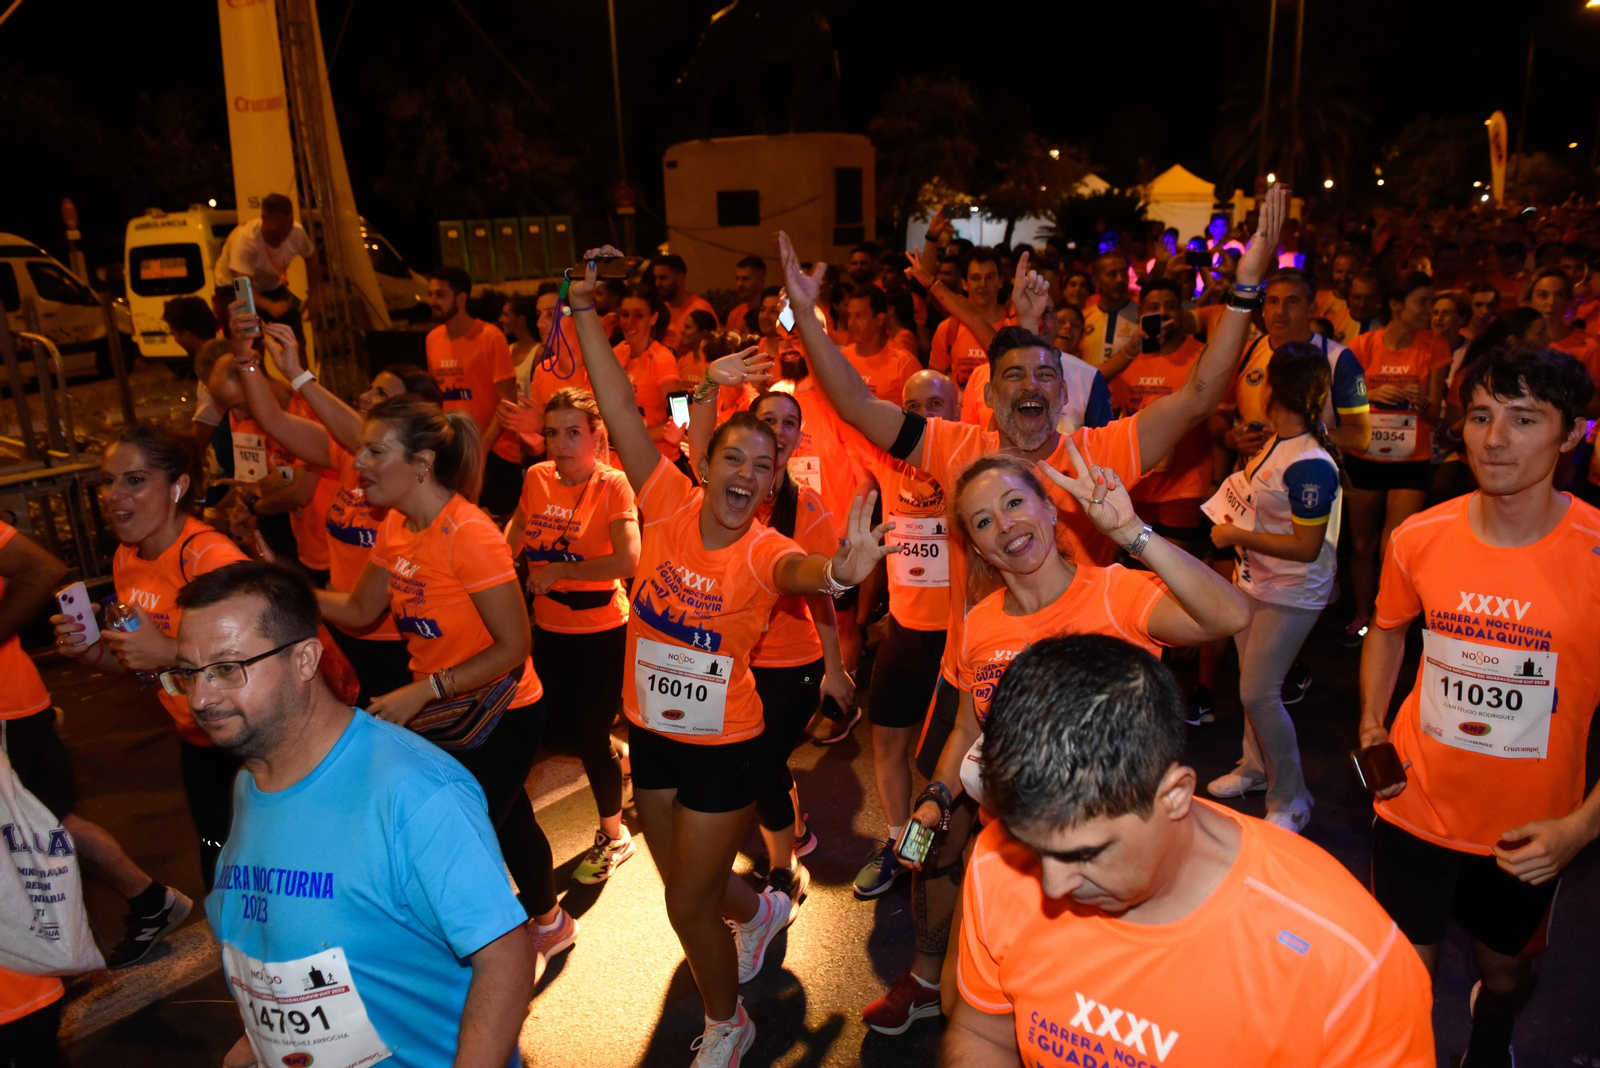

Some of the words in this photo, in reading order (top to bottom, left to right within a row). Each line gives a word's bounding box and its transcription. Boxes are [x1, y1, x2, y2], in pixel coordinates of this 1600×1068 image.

[1138, 376, 1166, 386] XXXV
[1380, 365, 1410, 375] XXXV
[1225, 488, 1247, 517] 18077
[660, 569, 722, 613] GUADALQUIVIR
[1457, 591, 1532, 621] XXXV
[1430, 609, 1481, 625] CARRERA
[1486, 619, 1552, 640] NOCTURNA
[1437, 620, 1551, 652] GUADALQUIVIR
[648, 674, 707, 702] 16010
[1453, 667, 1477, 678] NOCTURNA
[1486, 674, 1523, 685] GUADALQUIVIR
[1441, 675, 1523, 712] 11030
[1443, 702, 1457, 711] JUAN
[1457, 705, 1477, 716] FEIJOO
[1478, 711, 1516, 722] RODRIGUEZ
[1462, 724, 1486, 734] KH7
[1504, 745, 1540, 753] Cruzcampo
[253, 866, 335, 900] NOCTURNA
[242, 894, 269, 924] 2023
[331, 986, 345, 995] 2023
[249, 1001, 330, 1035] 14791
[1069, 991, 1180, 1063] XXXV
[313, 1033, 350, 1045] ARROCHA
[1028, 1025, 1037, 1045] DEL
[1030, 1011, 1106, 1057] CARRERA
